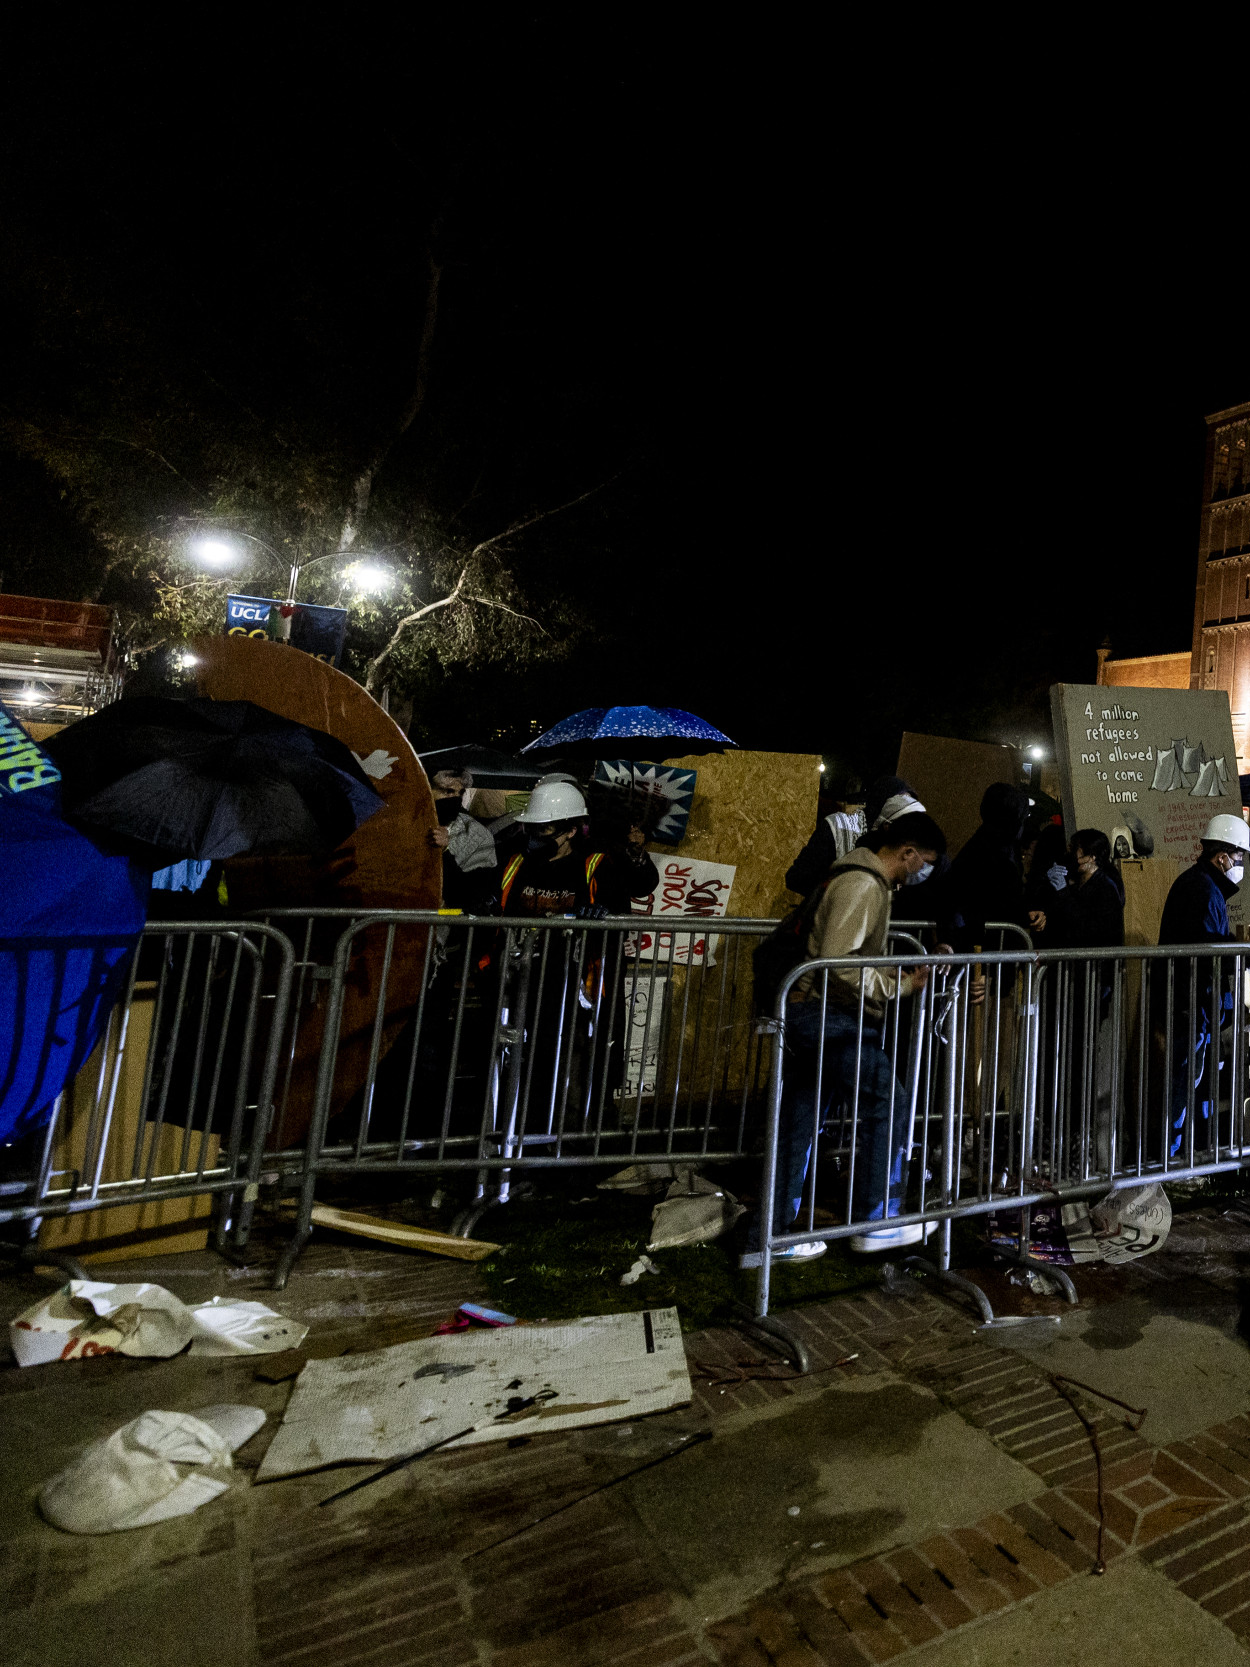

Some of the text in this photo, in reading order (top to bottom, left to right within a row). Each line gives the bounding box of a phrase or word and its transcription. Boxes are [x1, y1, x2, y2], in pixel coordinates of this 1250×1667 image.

[1085, 702, 1139, 720] 4 million
[1086, 722, 1139, 744] refugees
[1081, 746, 1153, 764] not allowed
[1096, 770, 1143, 781] to come
[1107, 784, 1138, 803] home
[660, 863, 693, 912] YOUR
[684, 879, 723, 917] NDS
